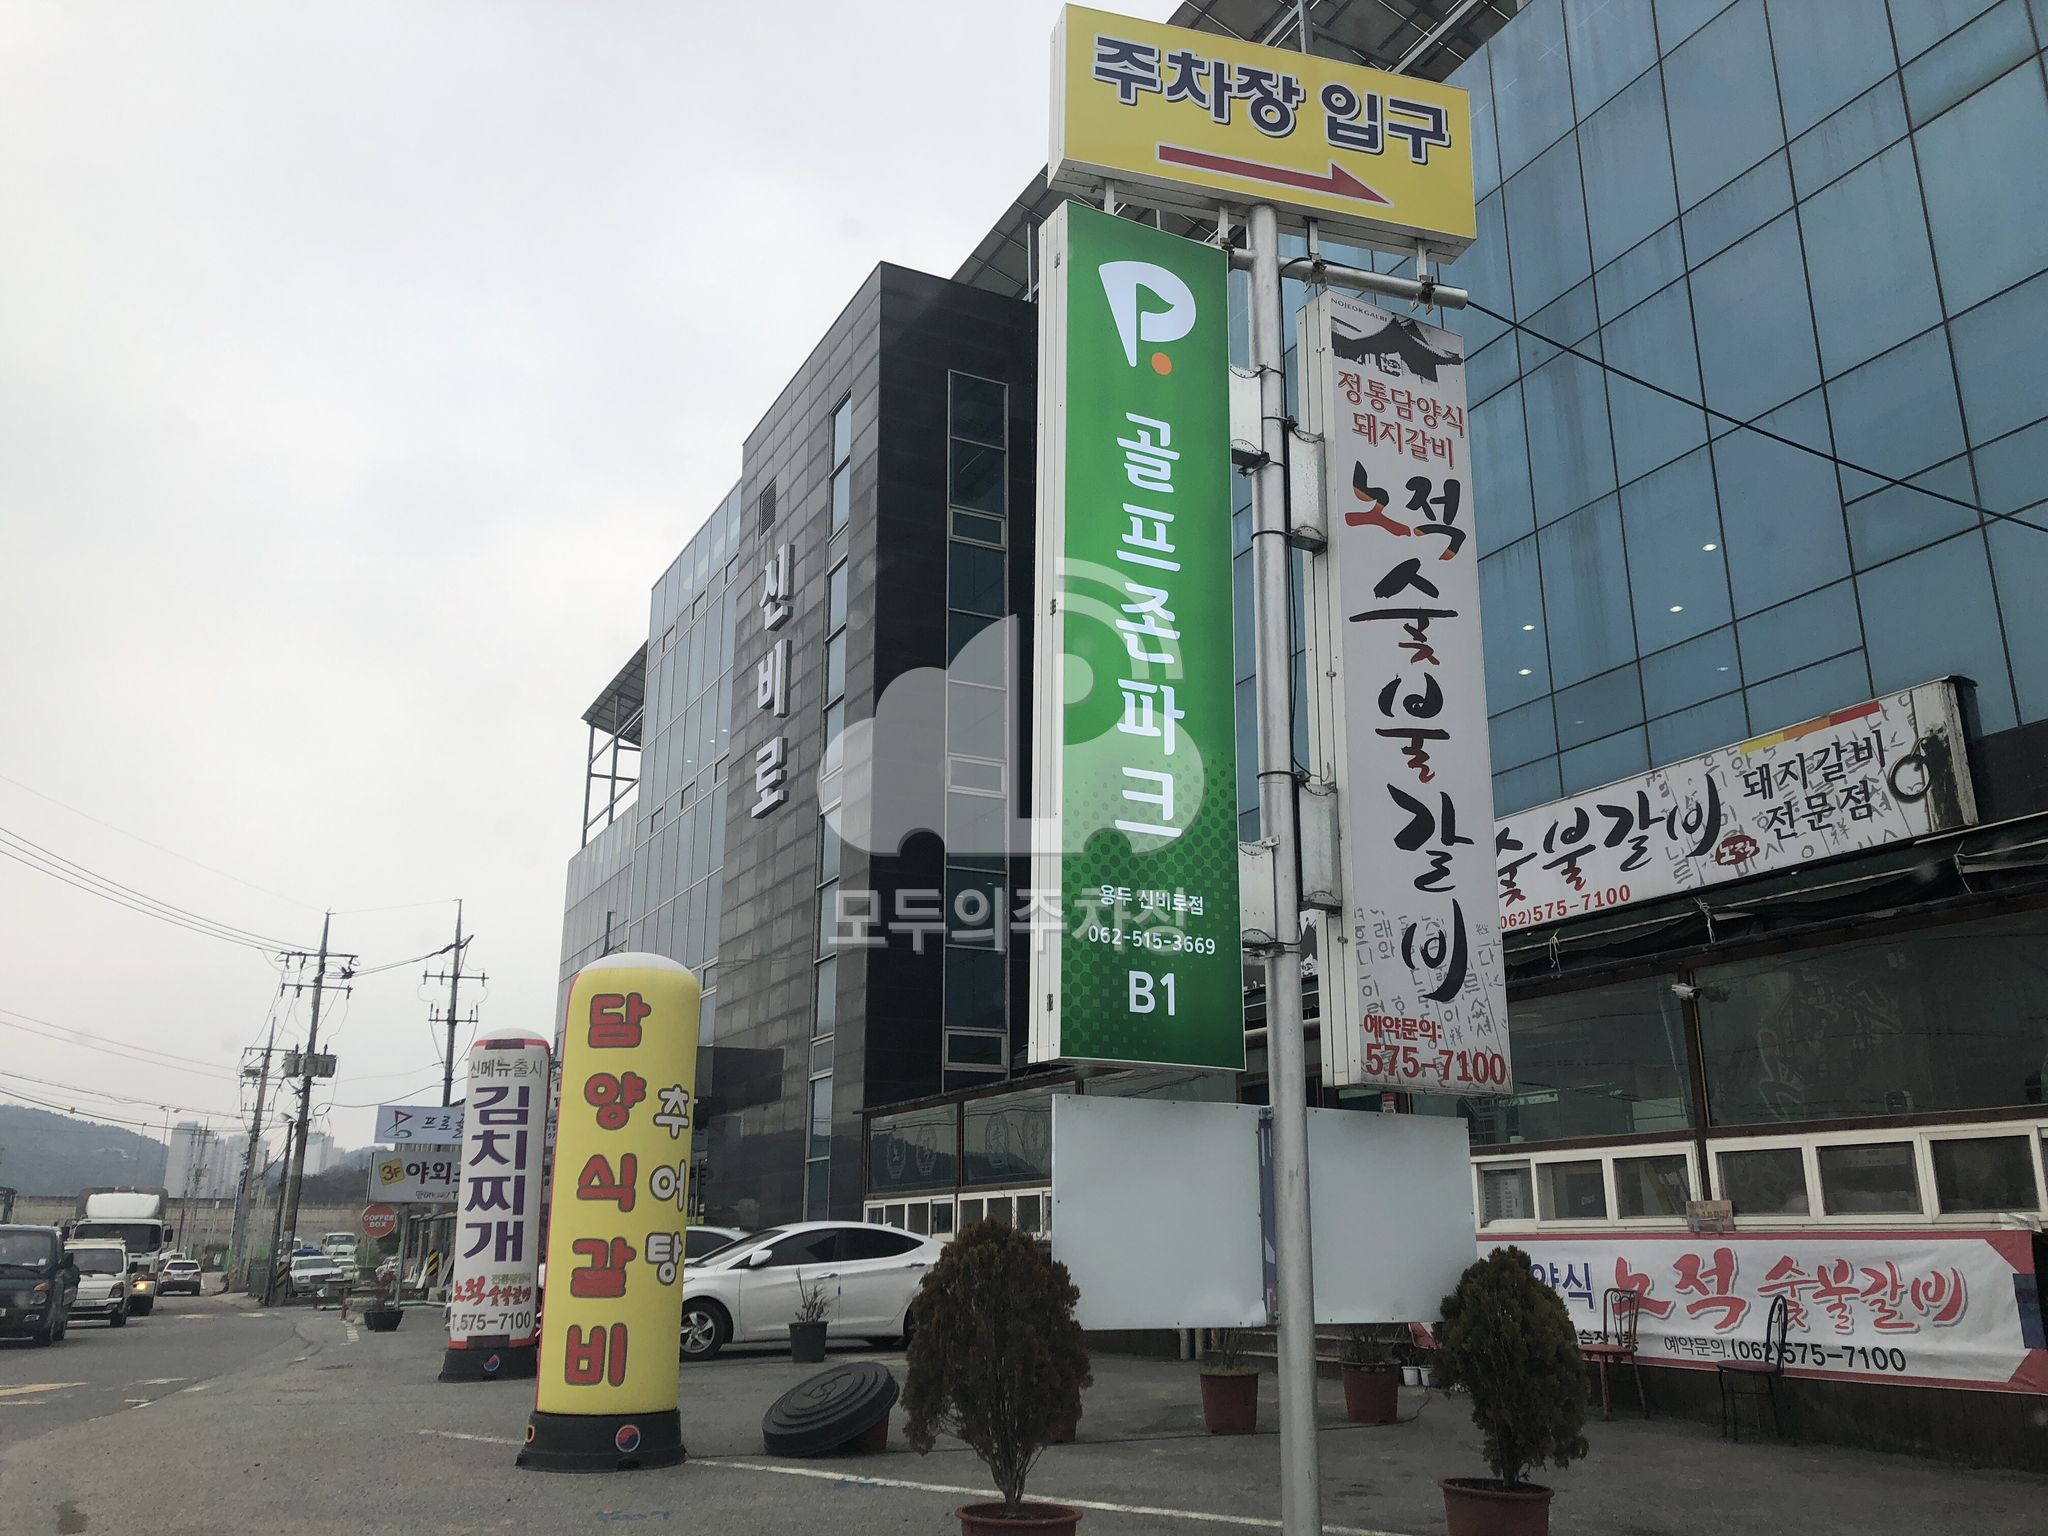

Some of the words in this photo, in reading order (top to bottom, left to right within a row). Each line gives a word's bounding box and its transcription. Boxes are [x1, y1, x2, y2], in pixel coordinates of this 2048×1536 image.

[1092, 34, 1305, 137] 주차장
[1319, 81, 1451, 164] 입구
[1337, 369, 1465, 438] 정통담양식
[1351, 411, 1455, 470] 돼지갈비
[1344, 460, 1467, 561] 노적
[1115, 411, 1186, 838] 골프존파크
[751, 543, 796, 819] 신비로
[1348, 556, 1477, 1004] 숯불갈비
[1742, 729, 1887, 801] 돼지갈비
[1765, 779, 1875, 842] 전문점
[1099, 884, 1133, 907] 용두
[1138, 889, 1204, 916] 신비로점
[1088, 925, 1217, 955] 062-515-3669
[1128, 970, 1176, 1017] B1
[1363, 1013, 1443, 1042] 예약문의:
[1365, 1042, 1507, 1086] 575-7100
[382, 1164, 401, 1182] 3F
[463, 1085, 530, 1263] 김치찌개
[564, 991, 651, 1388] 담양식갈비
[645, 1083, 690, 1287] 추어탕
[363, 1214, 394, 1222] COFFEE
[1613, 1247, 1749, 1331] 노적
